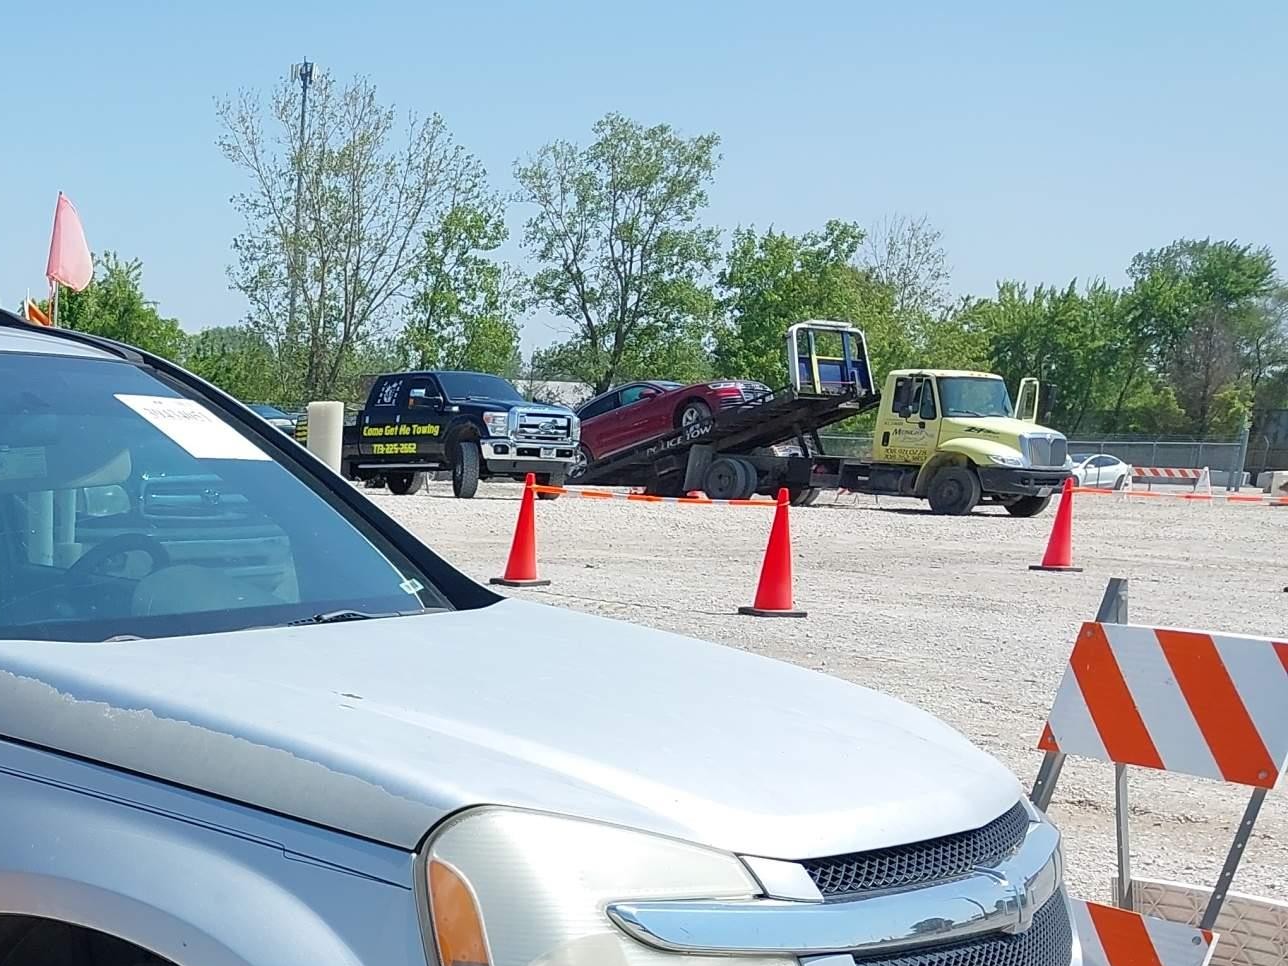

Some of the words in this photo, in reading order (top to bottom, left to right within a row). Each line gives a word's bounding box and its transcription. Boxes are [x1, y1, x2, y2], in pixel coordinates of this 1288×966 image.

[363, 426, 383, 436] Come
[384, 425, 399, 436] Get
[400, 424, 411, 436] Me
[412, 424, 440, 436] Towing
